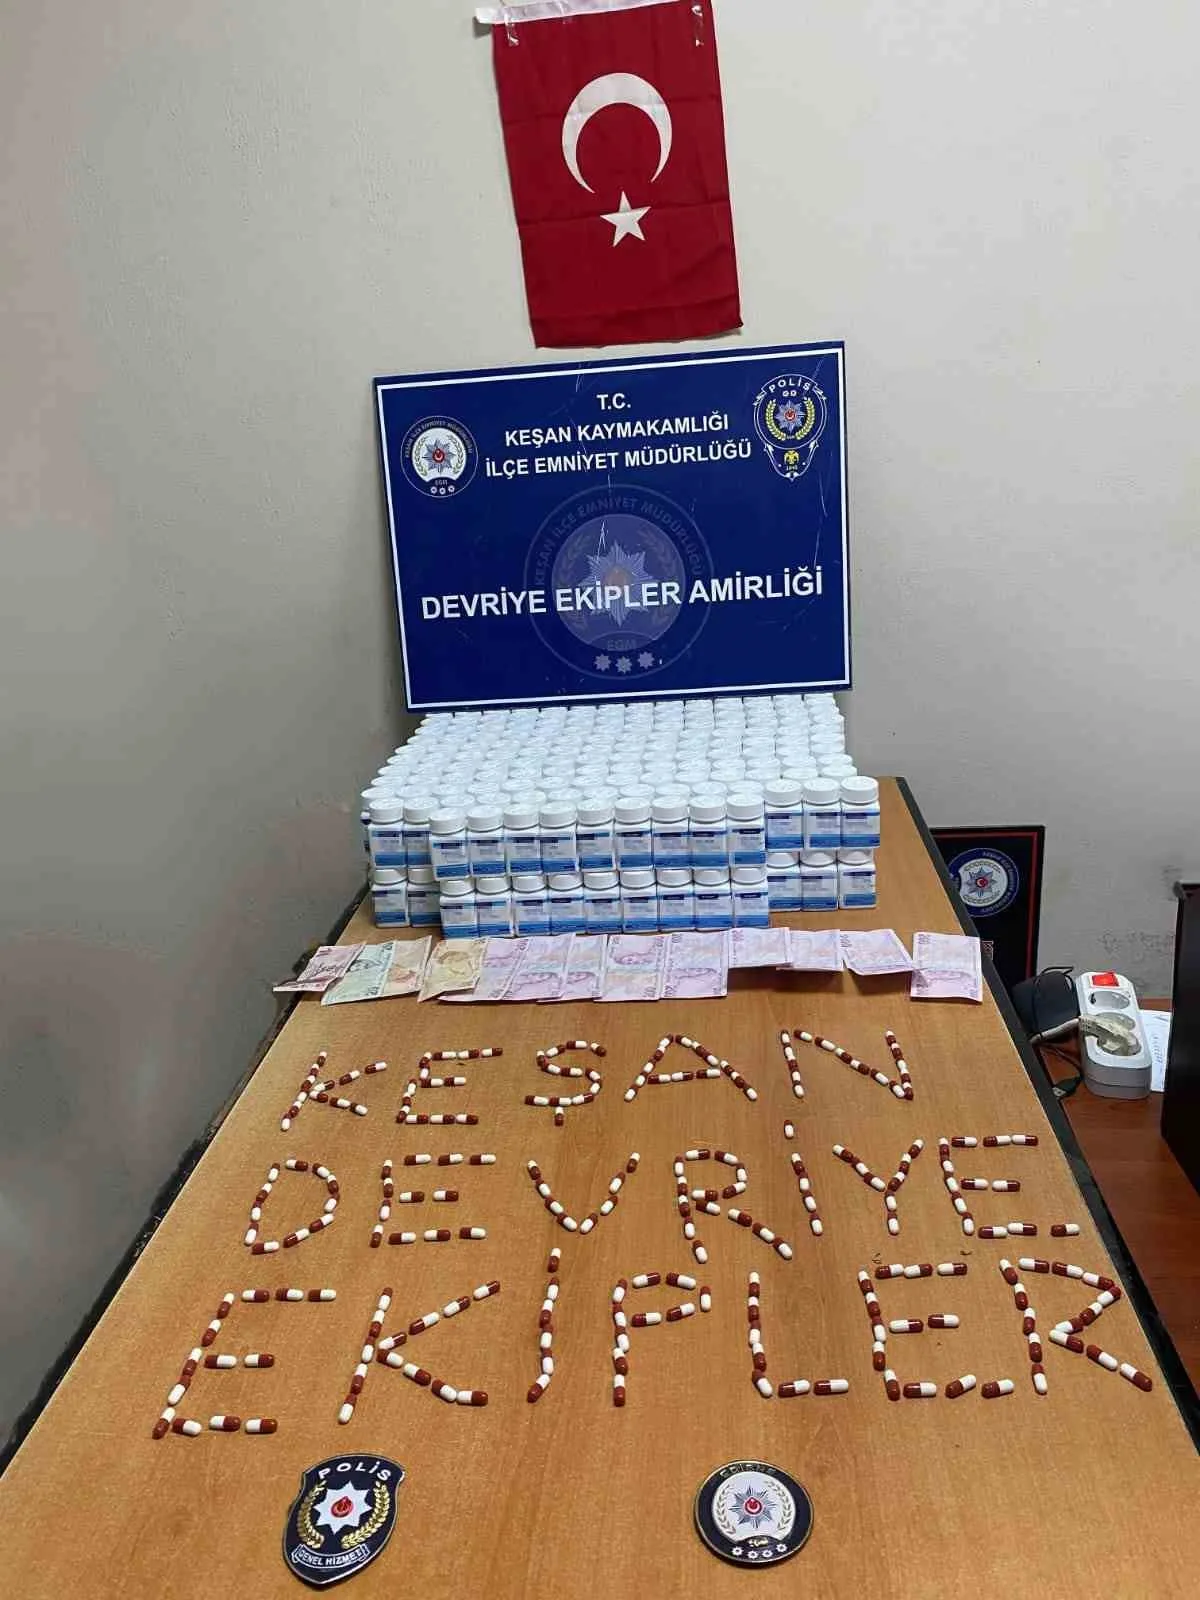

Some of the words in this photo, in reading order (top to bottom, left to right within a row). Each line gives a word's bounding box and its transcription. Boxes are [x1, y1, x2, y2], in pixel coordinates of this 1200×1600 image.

[596, 393, 631, 410] T.C.
[768, 377, 811, 393] POLİS
[505, 426, 572, 448] KEŞAN
[577, 410, 729, 442] KAYMAKAMLIĞI
[486, 457, 529, 479] İLÇE
[534, 450, 619, 474] EMNİYET
[624, 438, 752, 468] MÜDÜRLÜĞÜ
[421, 587, 547, 620] DEVRİYE
[556, 581, 682, 613] EKİPLER
[689, 566, 824, 604] AMİRLİĞİ
[280, 1028, 914, 1127] KEŞAN
[245, 1119, 1081, 1264] DEVRİYE
[152, 1247, 1153, 1440] EKİPLER
[318, 1461, 391, 1481] POLİS
[298, 1550, 323, 1566] GENEL
[325, 1549, 363, 1566] HİZMET
